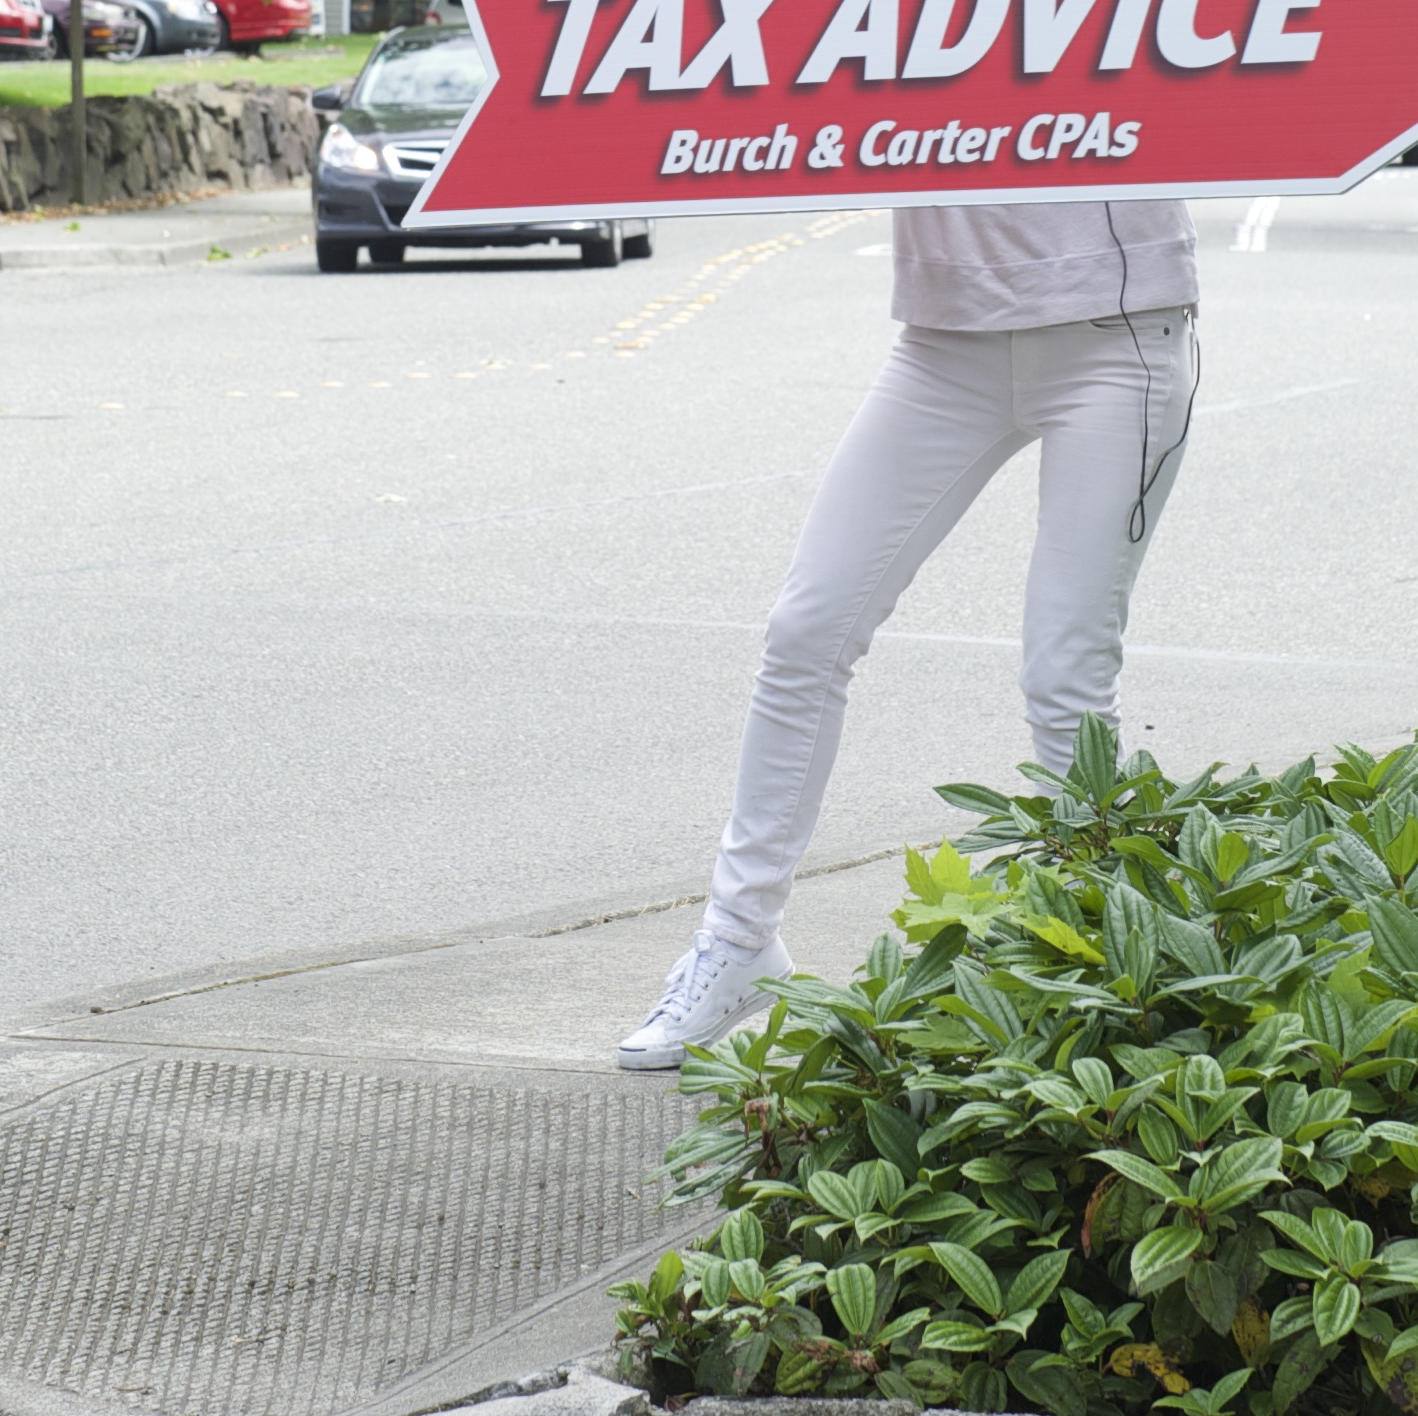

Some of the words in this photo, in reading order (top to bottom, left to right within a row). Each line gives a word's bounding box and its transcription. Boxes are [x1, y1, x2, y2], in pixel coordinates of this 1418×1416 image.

[661, 124, 796, 175] Burch
[807, 124, 844, 169] &
[859, 119, 1012, 168] Carter
[1016, 112, 1141, 161] CPAs
